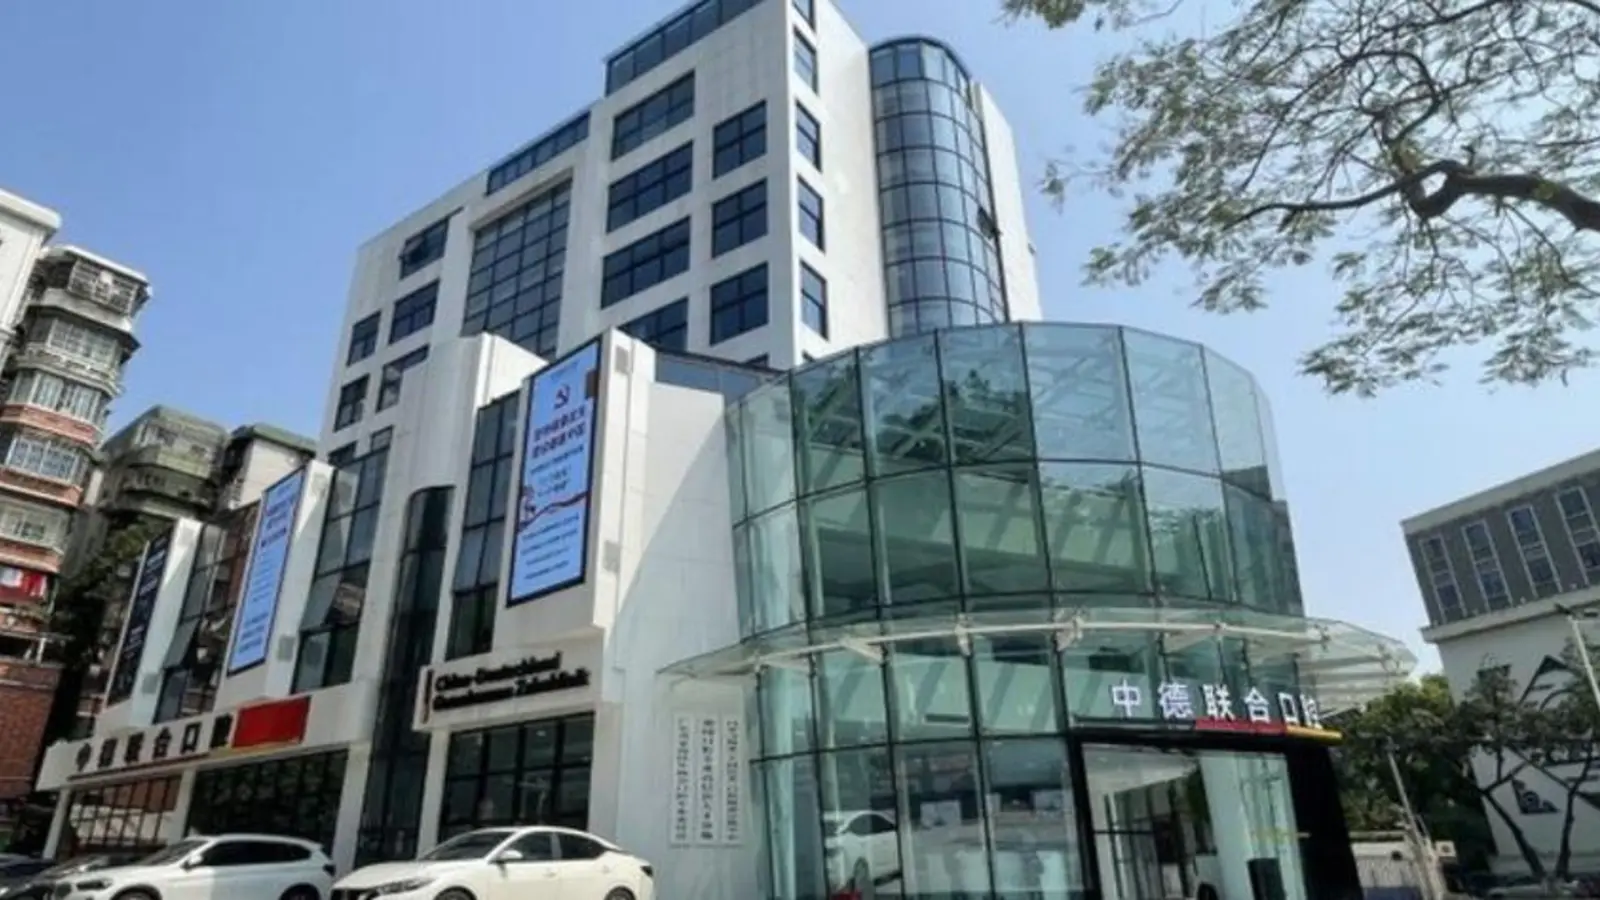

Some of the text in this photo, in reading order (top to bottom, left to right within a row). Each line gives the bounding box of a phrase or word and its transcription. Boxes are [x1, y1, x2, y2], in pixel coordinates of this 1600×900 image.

[1111, 677, 1323, 730] 中德联合口腔
